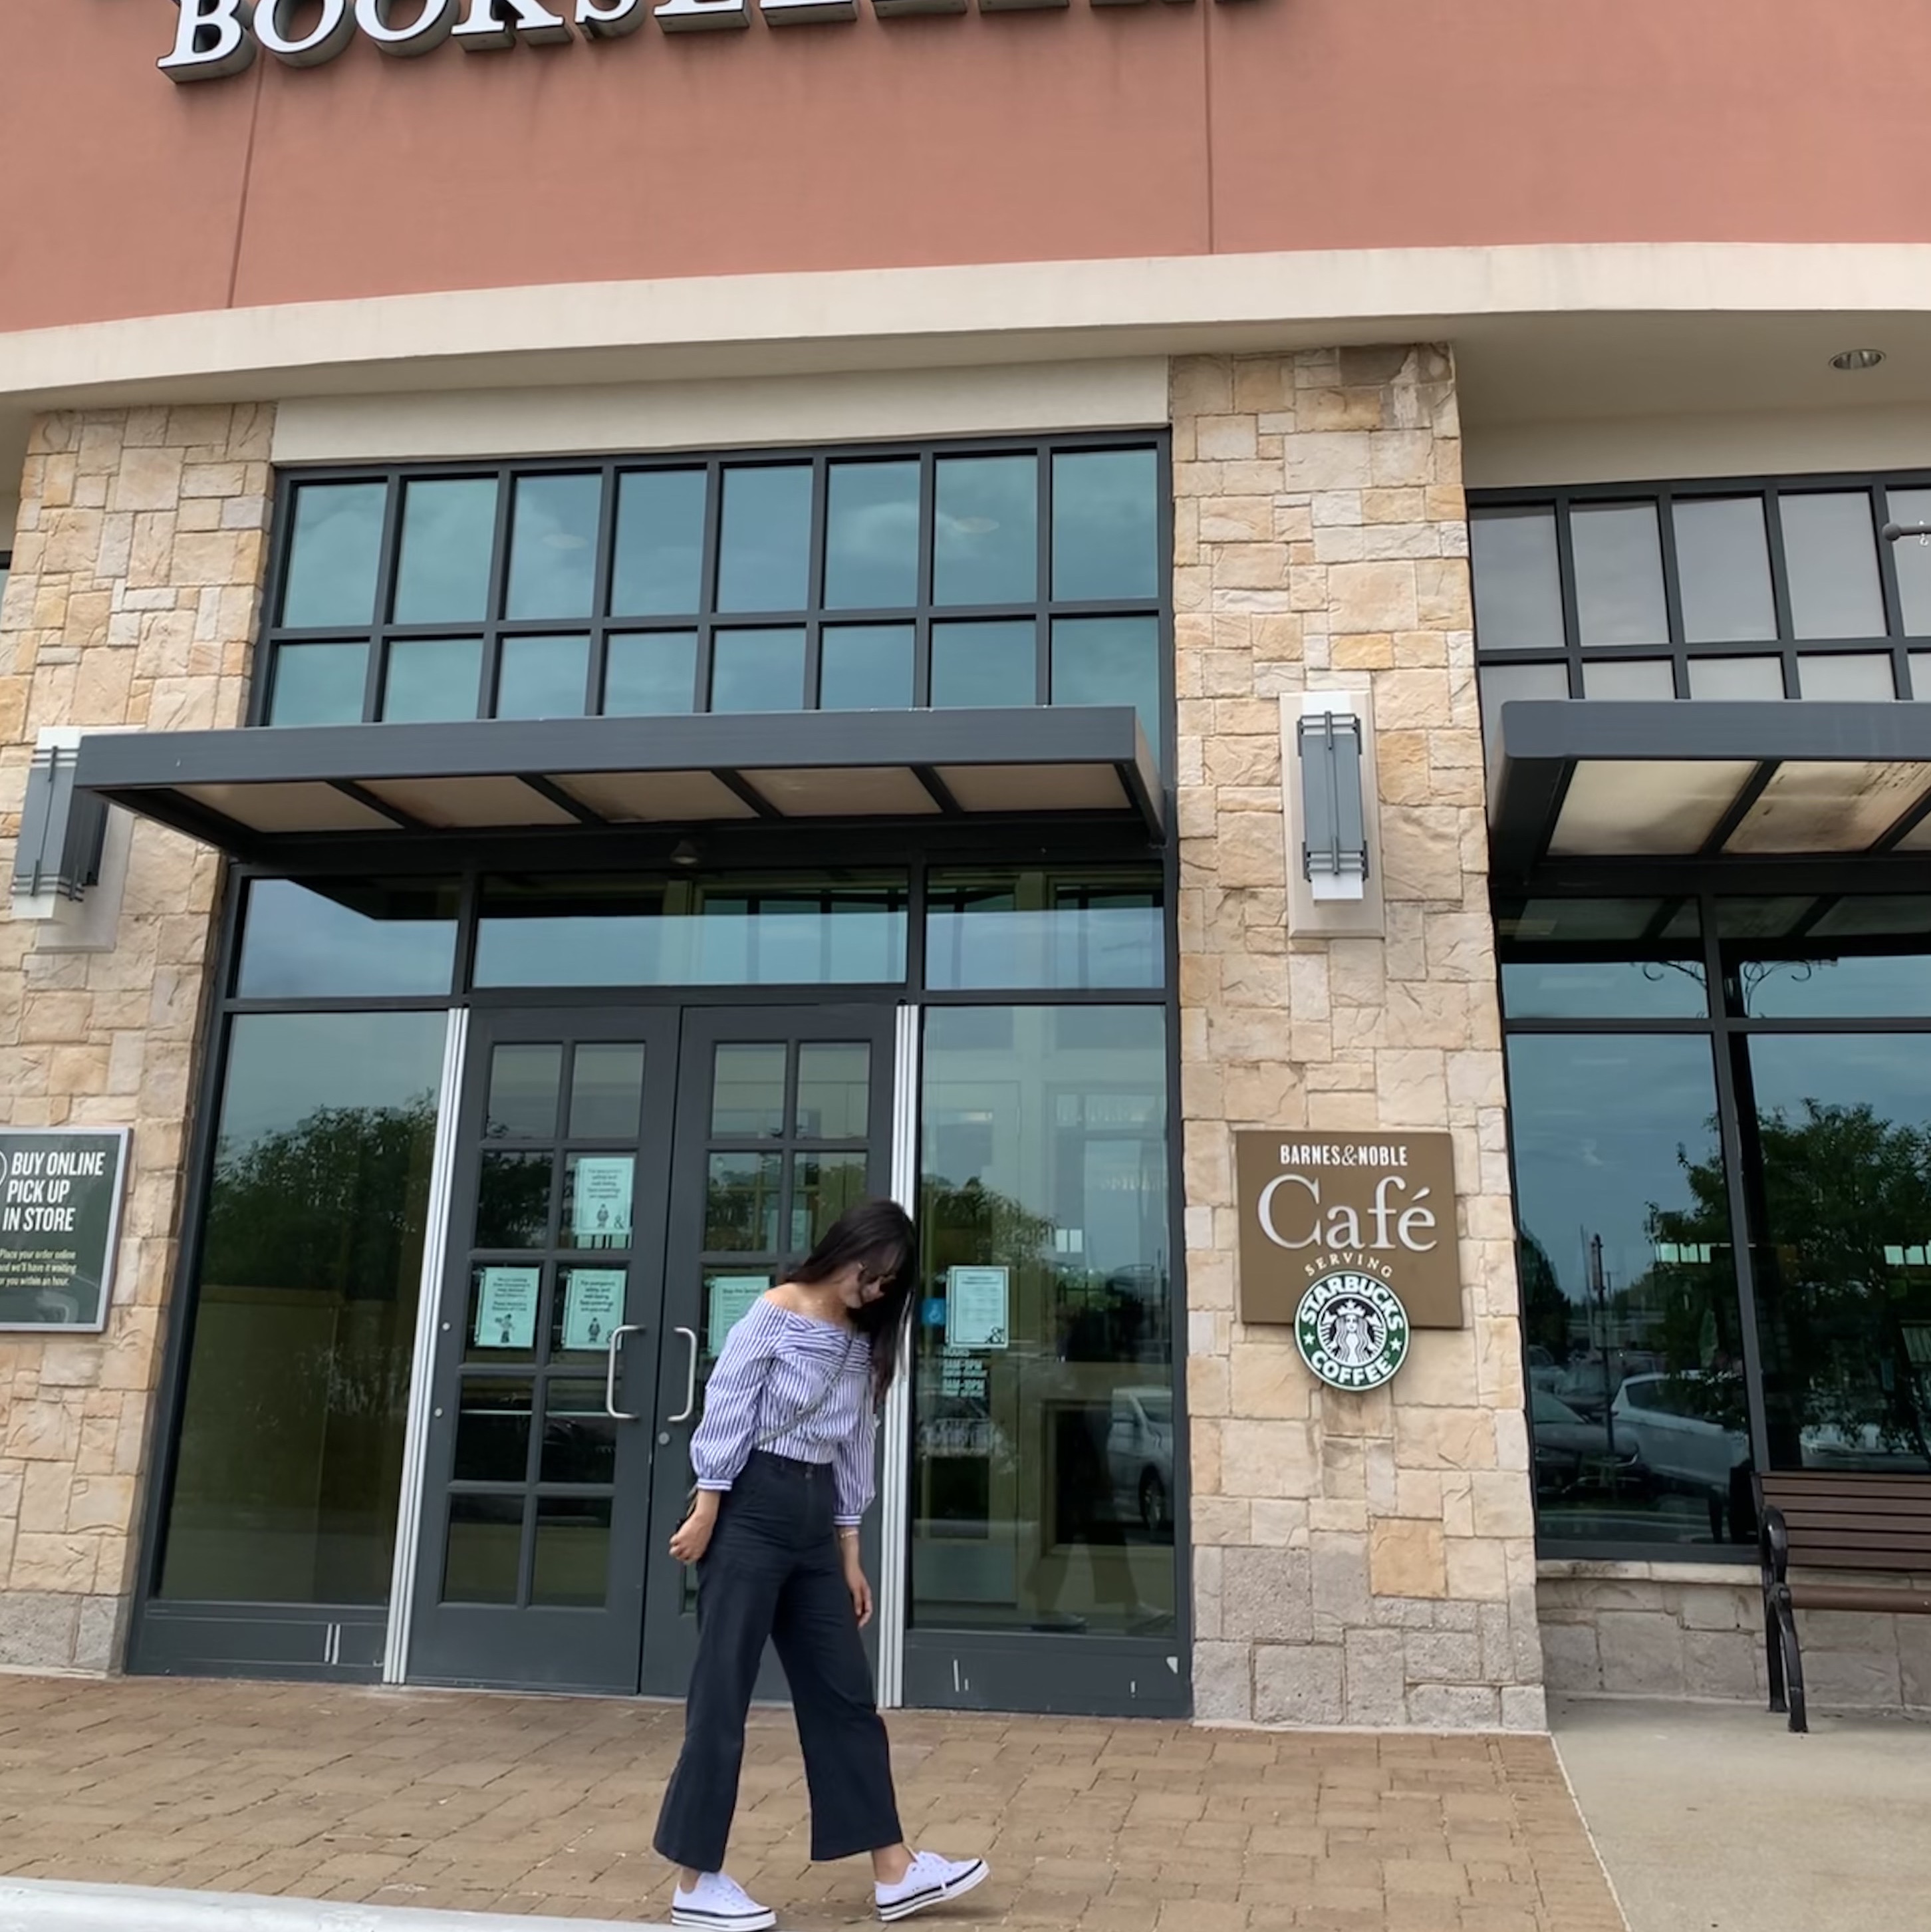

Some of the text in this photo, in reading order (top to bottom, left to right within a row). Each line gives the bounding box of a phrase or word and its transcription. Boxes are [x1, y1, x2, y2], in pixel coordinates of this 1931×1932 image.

[11, 1151, 106, 1176] BUY ONLINE
[6, 1179, 71, 1203] PICK UP
[2, 1207, 76, 1232] IN STORE
[1257, 1173, 1438, 1252] Café
[1304, 1252, 1393, 1278] SERVING
[1300, 1276, 1404, 1331] STARBUCKS
[1311, 1350, 1392, 1385] COFFEE
